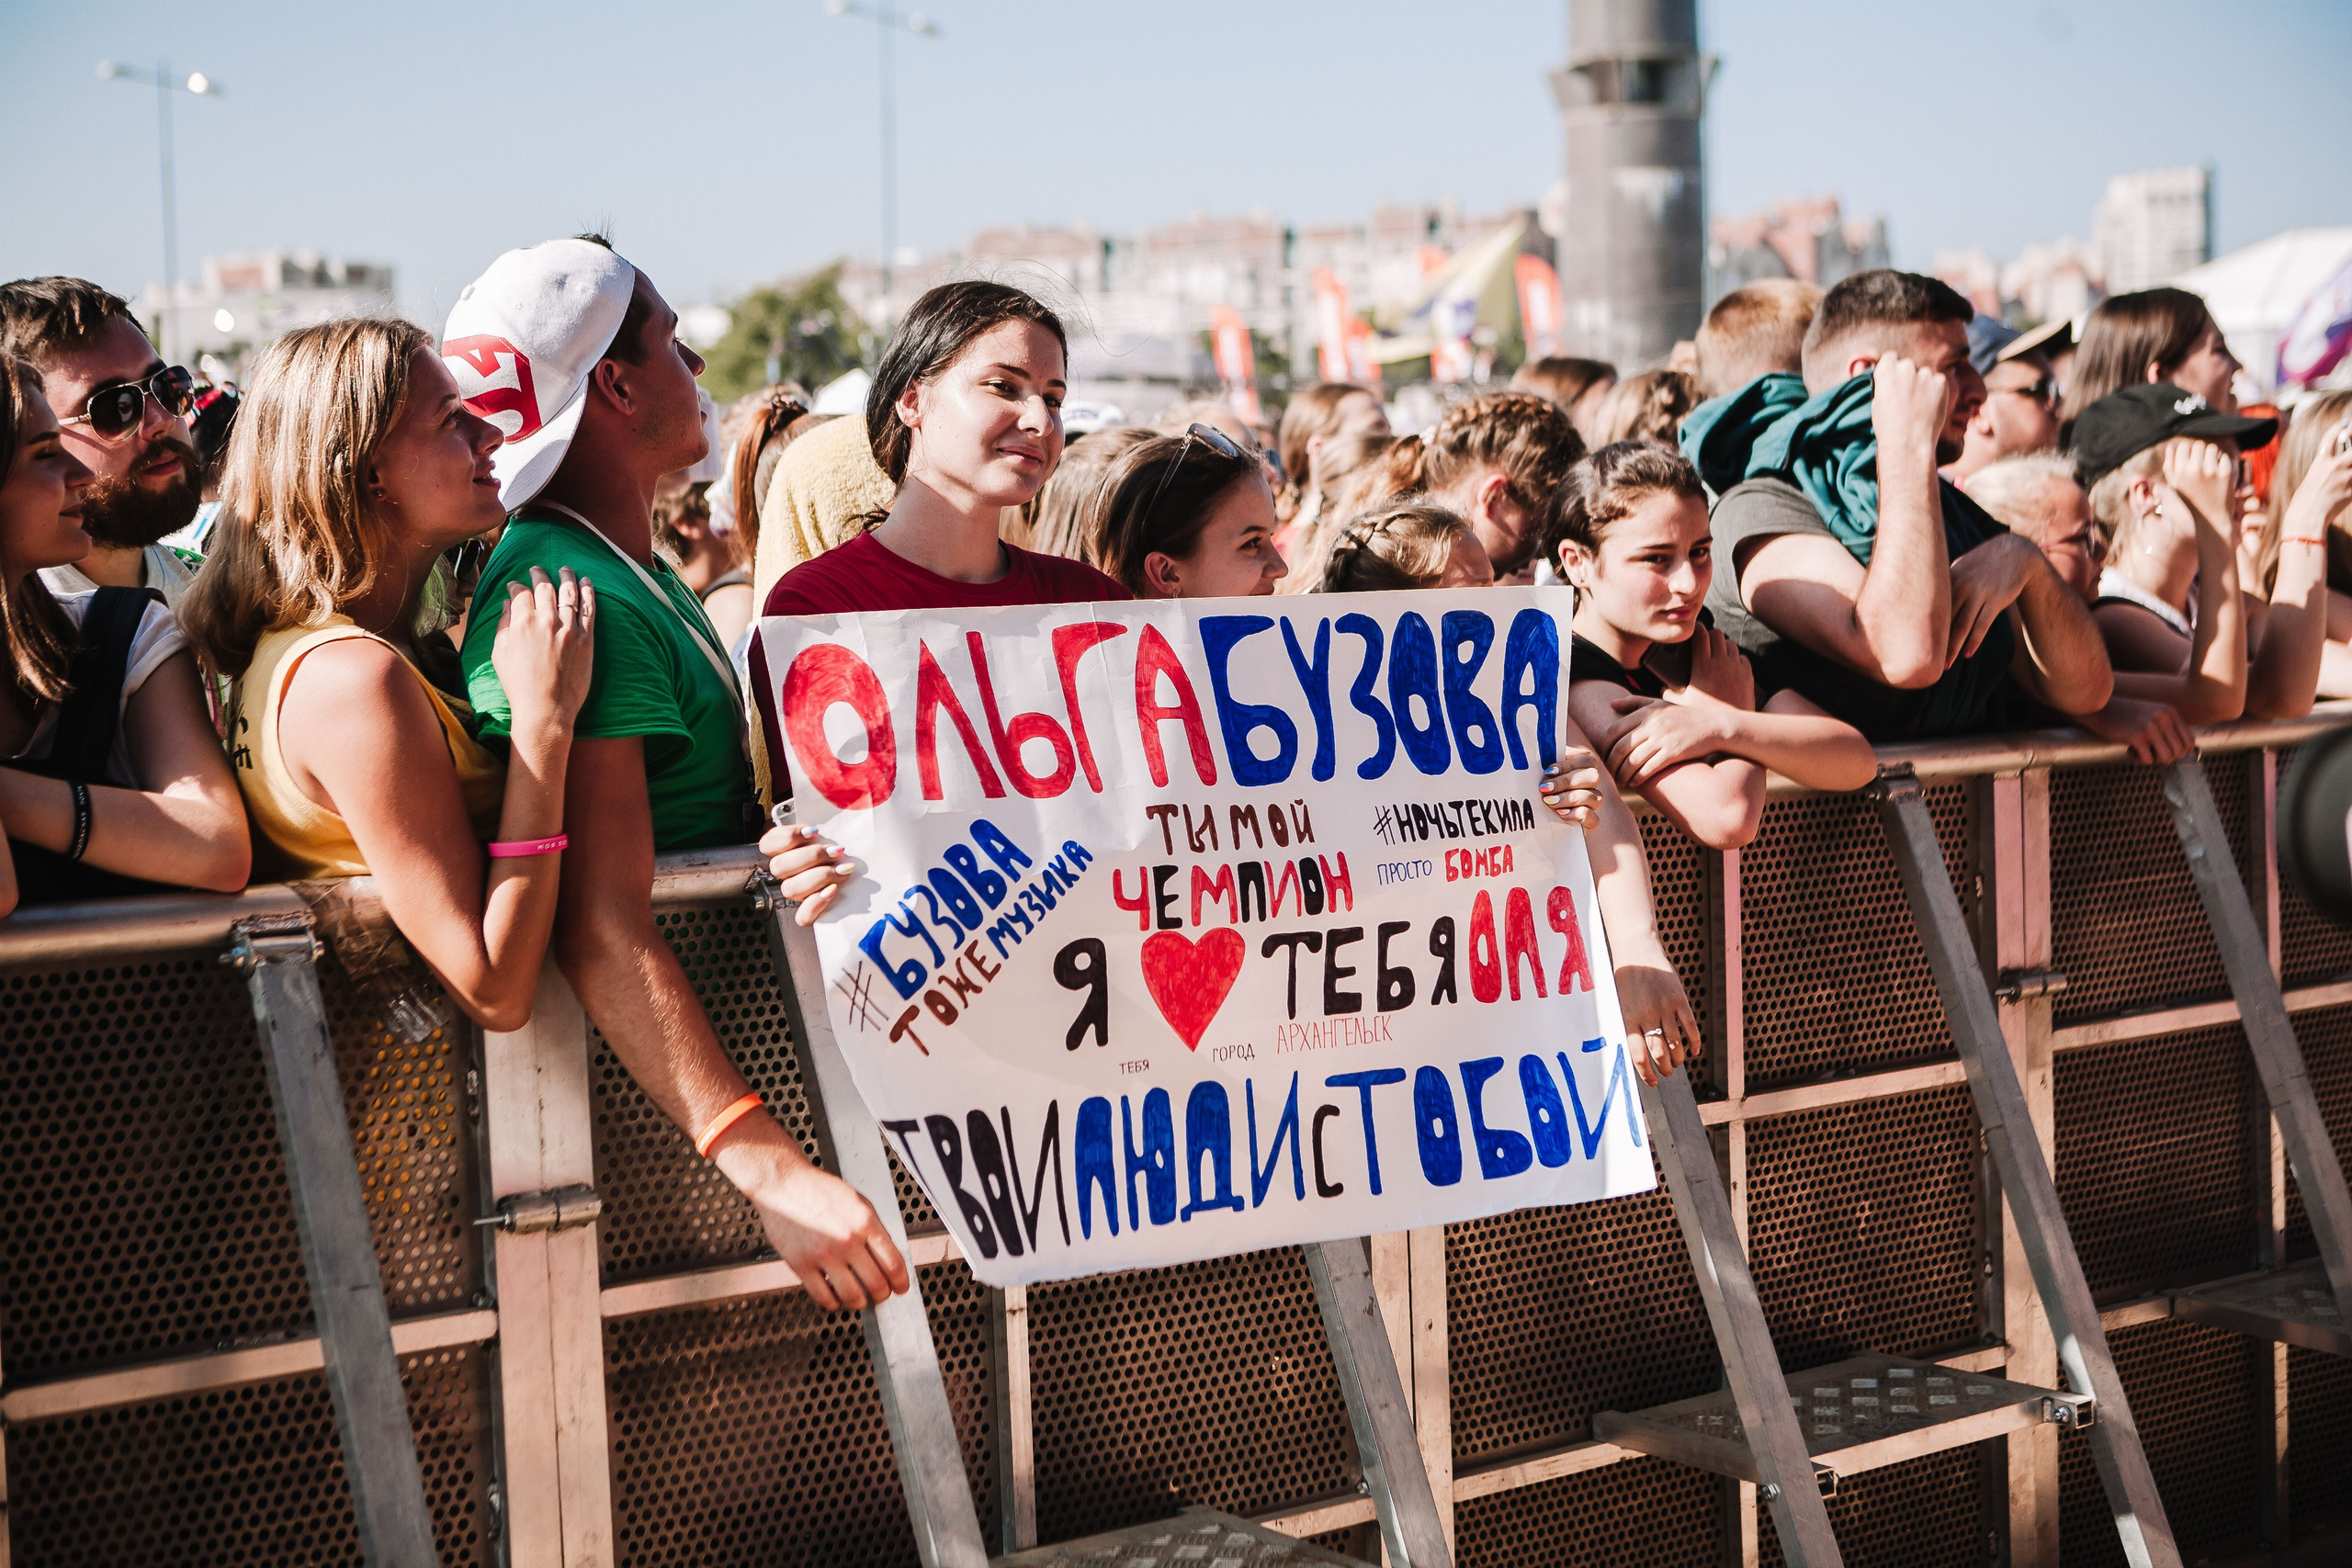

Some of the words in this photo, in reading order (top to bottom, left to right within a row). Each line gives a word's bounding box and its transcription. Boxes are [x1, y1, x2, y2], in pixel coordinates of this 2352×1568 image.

[784, 622, 1217, 809] ОЛЬГА
[1200, 609, 1559, 787] БУЗОВА
[1229, 798, 1315, 851] МОЙ
[1377, 859, 1432, 886] ПРОСТО
[1444, 843, 1514, 882] БОМБА
[831, 818, 1033, 1032] #БУЗОВА
[1113, 851, 1353, 931] ЧЕМПИОН
[1053, 937, 1109, 1051] Я
[1261, 916, 1457, 1020] ТЕБЯ
[1469, 886, 1596, 1004] ОЛЯ
[1119, 1059, 1149, 1076] ТЕБЯ
[1213, 1043, 1256, 1063] ГОРОД
[1276, 1015, 1394, 1055] АРХАНГЕЛЬСК
